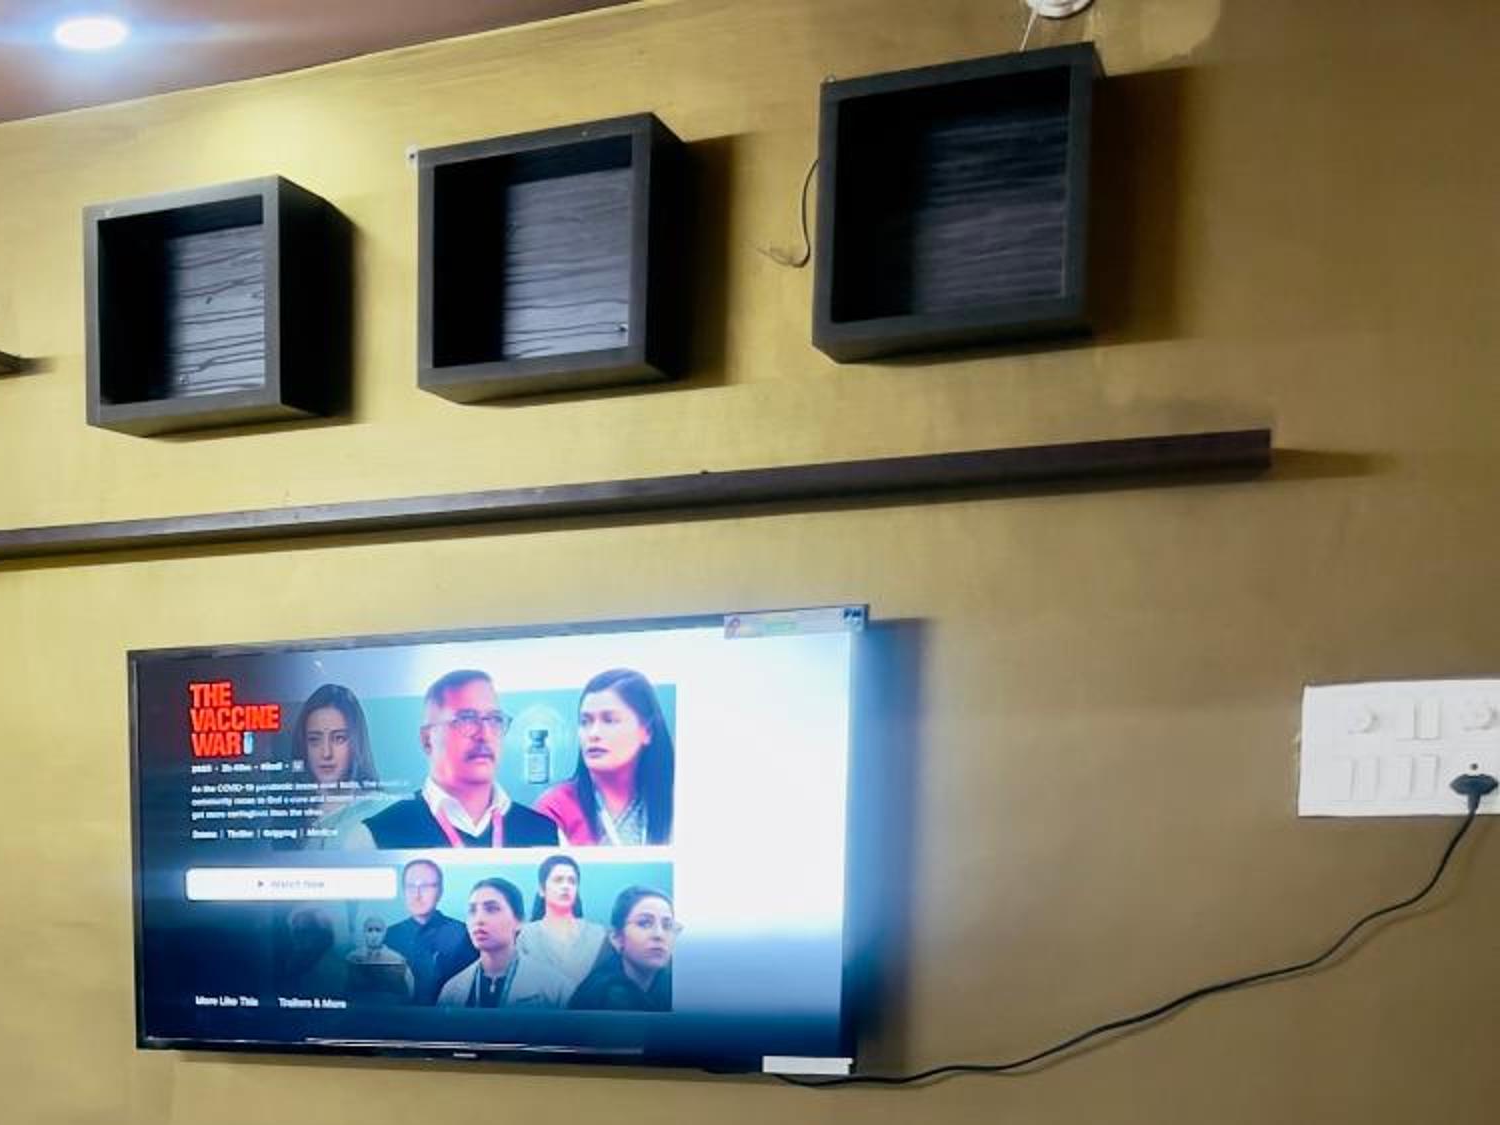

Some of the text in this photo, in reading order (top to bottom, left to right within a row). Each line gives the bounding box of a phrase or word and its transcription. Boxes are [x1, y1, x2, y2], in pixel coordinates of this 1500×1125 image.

[190, 682, 231, 707] THE
[190, 705, 279, 732] VACCINE
[191, 731, 241, 756] WAR
[218, 783, 254, 793] COVID-19
